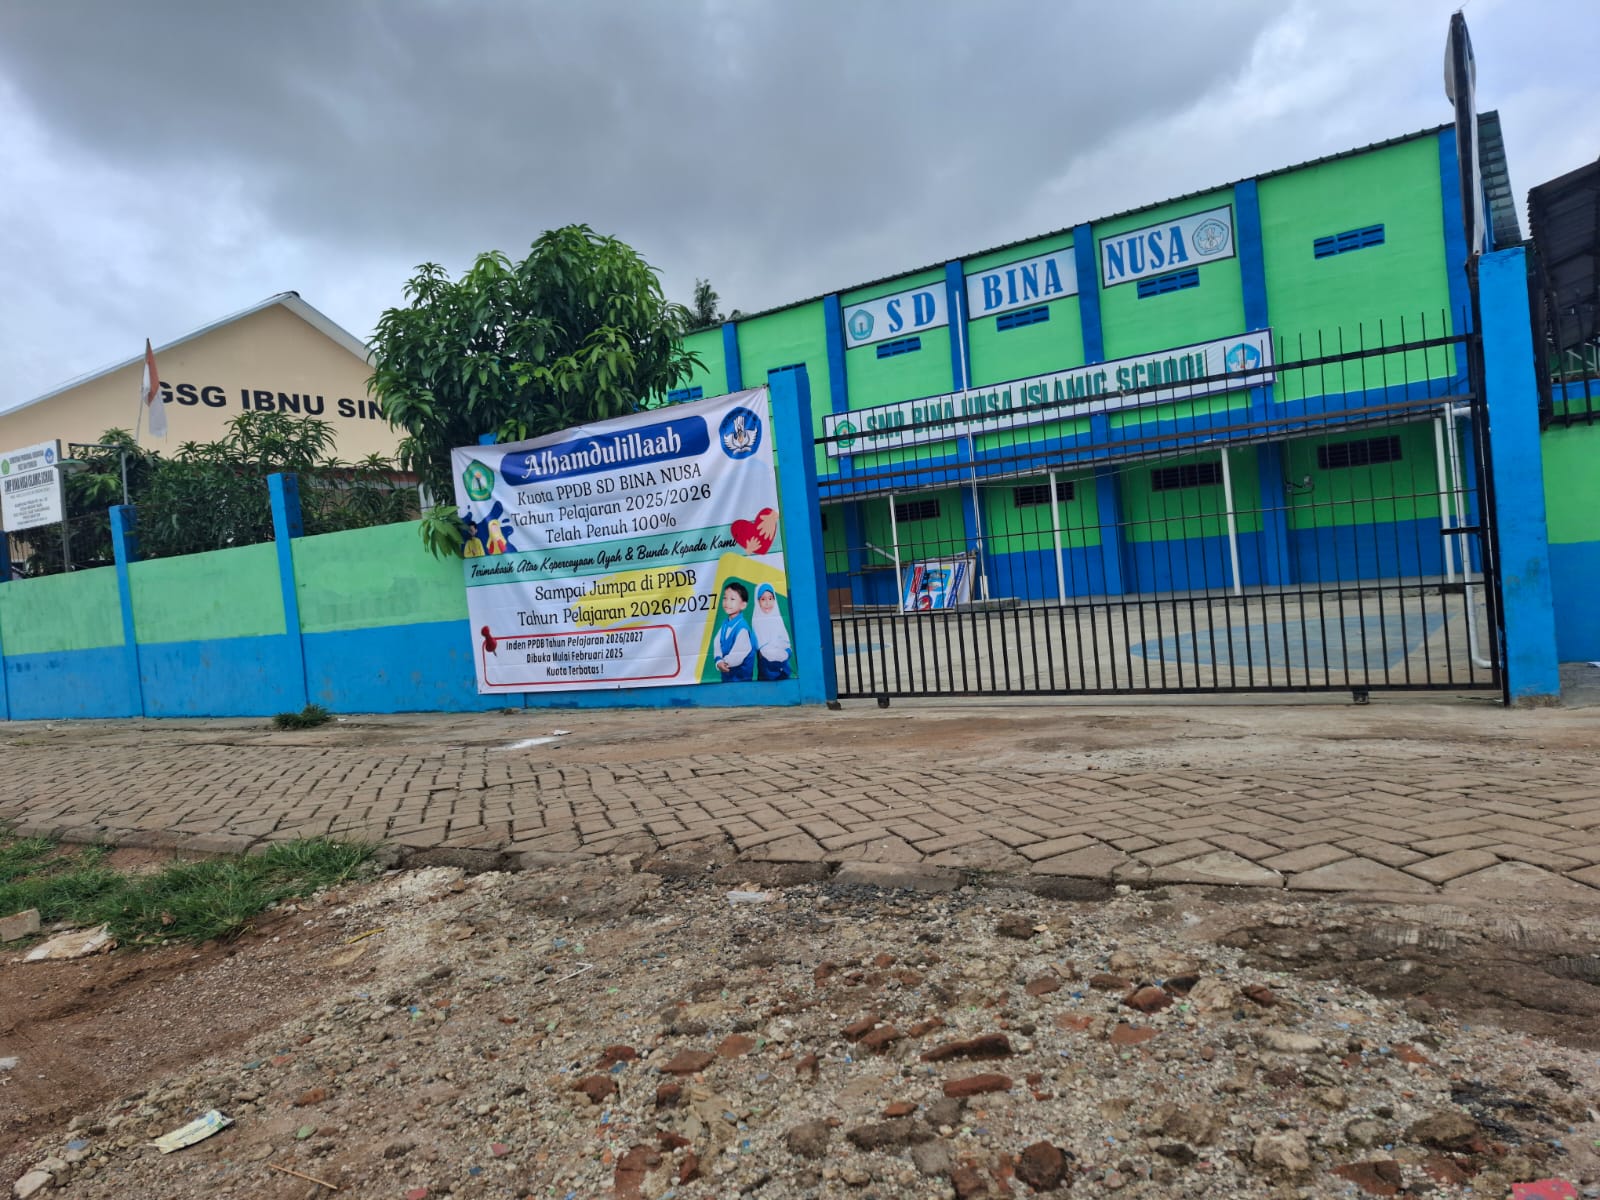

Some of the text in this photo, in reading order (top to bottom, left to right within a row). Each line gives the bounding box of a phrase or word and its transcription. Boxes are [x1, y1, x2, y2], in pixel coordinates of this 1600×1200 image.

[982, 258, 1063, 310] BINA
[1105, 225, 1189, 280] NUSA
[241, 389, 325, 416] IBNU
[866, 350, 1207, 442] SMP BINA NUSA ISLAMIC SCHOOL
[521, 426, 682, 479] Alhamdulillaah
[517, 463, 702, 506] Kuota PPDB SD BINA NUSA
[510, 483, 711, 527] Tahun Pelajaran 2025/2026
[545, 513, 676, 544] Telah Penuh 100%
[471, 534, 737, 579] Terimakasih Atas Kepercayaan Ayah & Bunda Kepada Kami
[535, 569, 697, 603] Sampai Jumpa di PPDB
[517, 593, 718, 628] Tahun Pelajaran 2026/2027
[506, 631, 643, 651] Inden PPDB Tahun Pelajaran 2026/2027
[526, 648, 623, 664] Dibuka Mulai Februari 2025
[546, 666, 567, 677] Kuota
[568, 664, 599, 676] Terbatas
